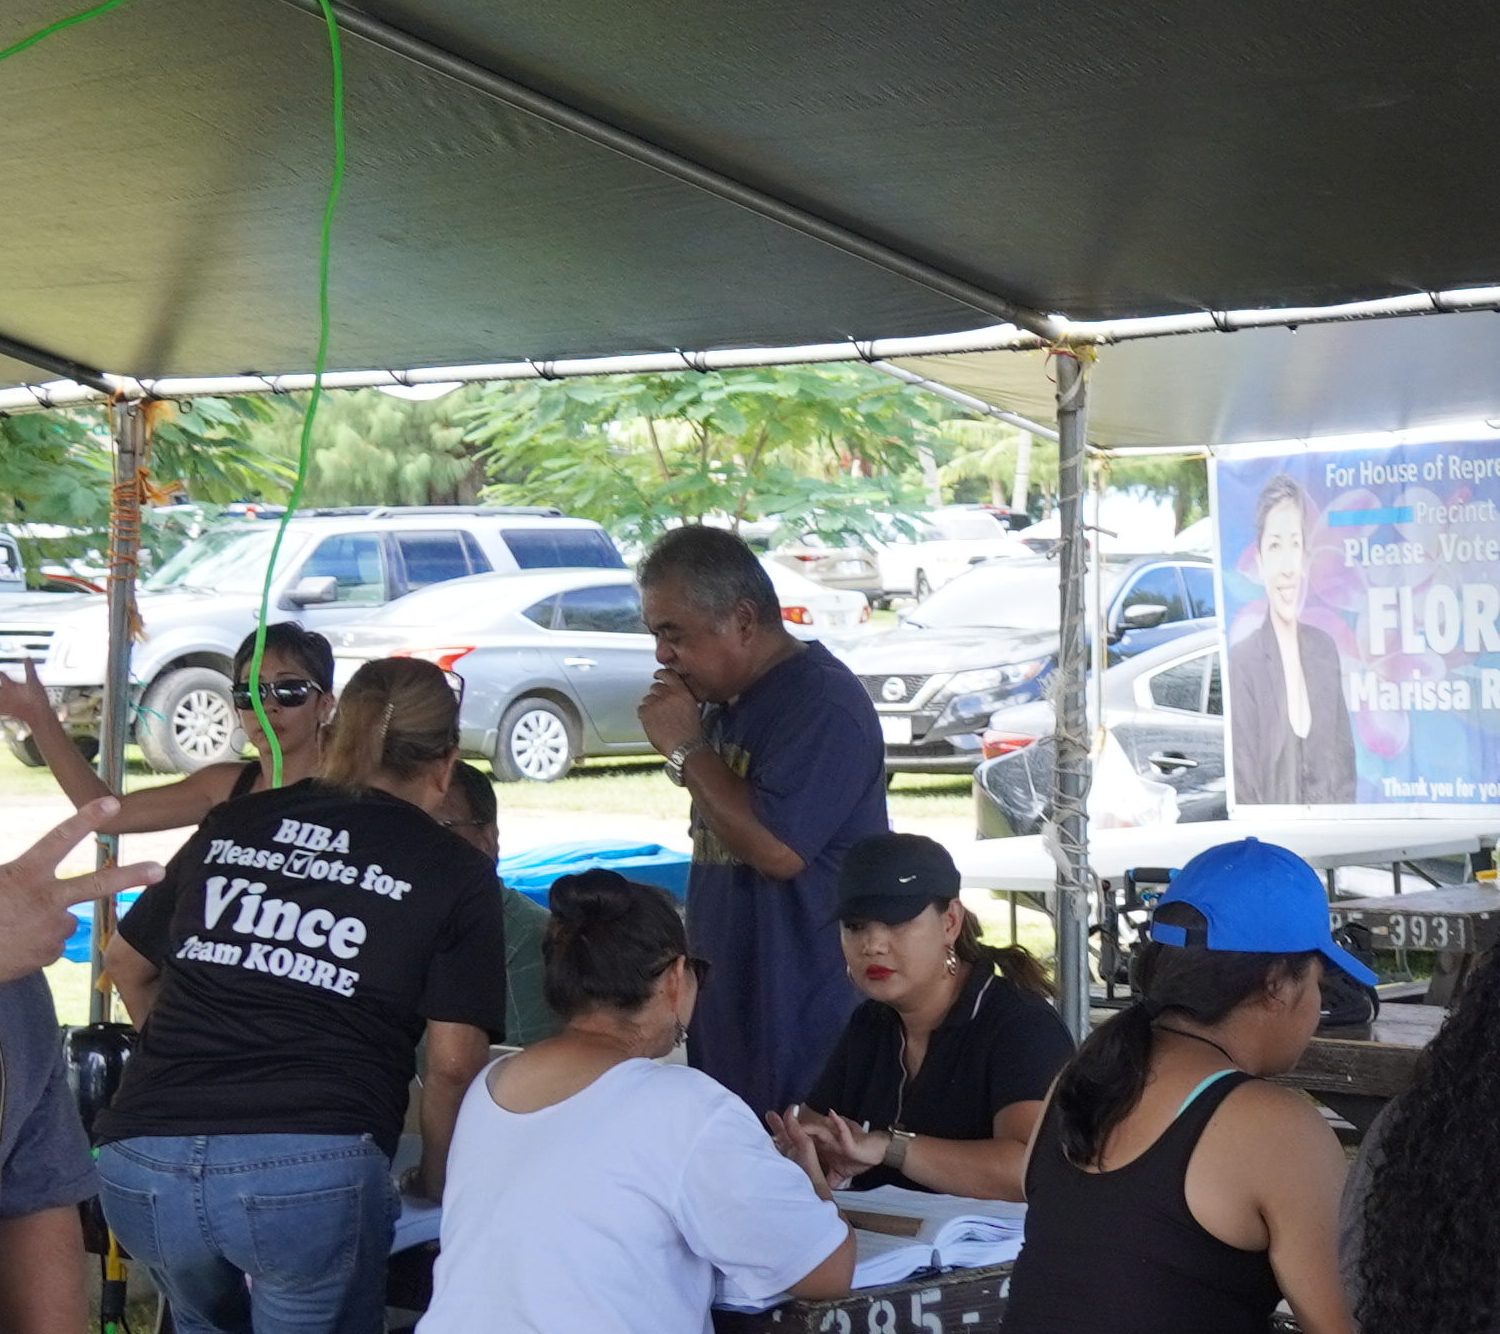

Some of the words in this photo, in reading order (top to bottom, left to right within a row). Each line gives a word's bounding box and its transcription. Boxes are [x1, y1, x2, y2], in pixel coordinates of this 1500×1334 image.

[1326, 463, 1355, 488] For
[1360, 460, 1417, 485] House
[1423, 454, 1443, 481] of
[1417, 499, 1495, 524] Precinct
[1344, 538, 1425, 568] Please
[1350, 669, 1471, 712] Marissa
[1382, 777, 1429, 798] Thank
[1431, 781, 1454, 800] you
[1456, 777, 1476, 797] for
[272, 818, 350, 854] BIBA
[203, 839, 285, 871] Please
[360, 864, 412, 900] for
[204, 875, 367, 959] Vince
[176, 934, 243, 966] Team
[242, 942, 360, 997] KOBRE
